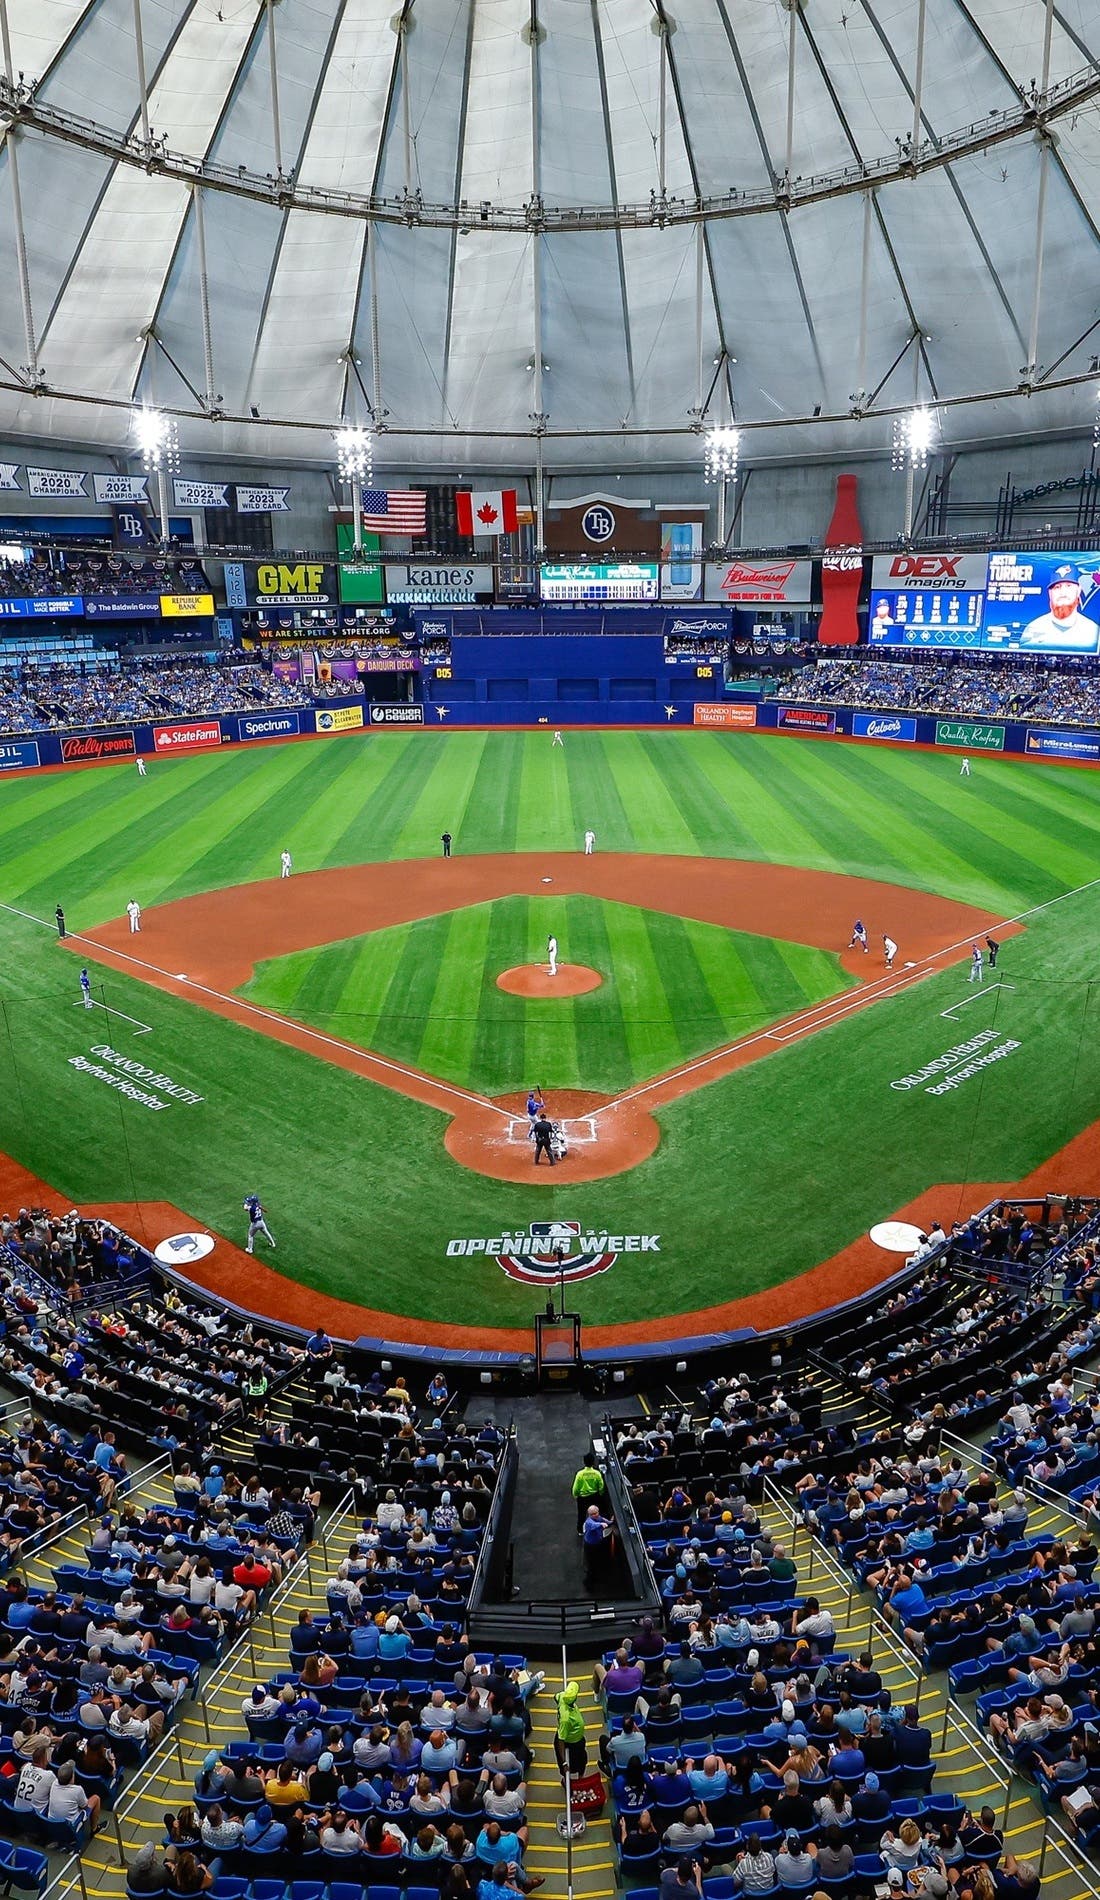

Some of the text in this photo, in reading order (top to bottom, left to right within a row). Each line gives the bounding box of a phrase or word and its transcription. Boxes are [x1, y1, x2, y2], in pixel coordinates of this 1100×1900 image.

[41, 478, 70, 488] 2020
[106, 483, 132, 492] 2021
[186, 488, 214, 499] 2022
[249, 495, 274, 503] 2023
[118, 514, 143, 538] TB
[588, 512, 610, 535] TB
[889, 557, 964, 577] DEX
[990, 555, 1016, 566] JUSTIN
[228, 566, 240, 577] 42
[730, 571, 787, 582] Budweiser
[990, 565, 1033, 581] TURNER
[230, 581, 241, 591] 12
[257, 565, 324, 594] GMF
[904, 577, 967, 588] imaging
[230, 594, 243, 605] 66
[367, 660, 414, 670] DAIQUIRI DECK
[436, 668, 452, 678] 0:05
[697, 667, 712, 677] 0:05
[785, 711, 828, 721] AMERICAN
[246, 720, 290, 735] Spectrum
[867, 720, 901, 736] Culver's
[940, 724, 1000, 747] Quality Roofing
[64, 736, 133, 758] Bally SPORTS
[1043, 740, 1099, 750] MicroLumen
[890, 1029, 1001, 1090] ORLANDO HEALTH
[925, 1038, 1022, 1096] Bayfront Hospital
[90, 1044, 205, 1104] ORLANDO HEALTH
[68, 1056, 171, 1111] Bayfront Hospital
[446, 1235, 661, 1256] OPENING WEEK
[18, 1781, 35, 1801] 22
